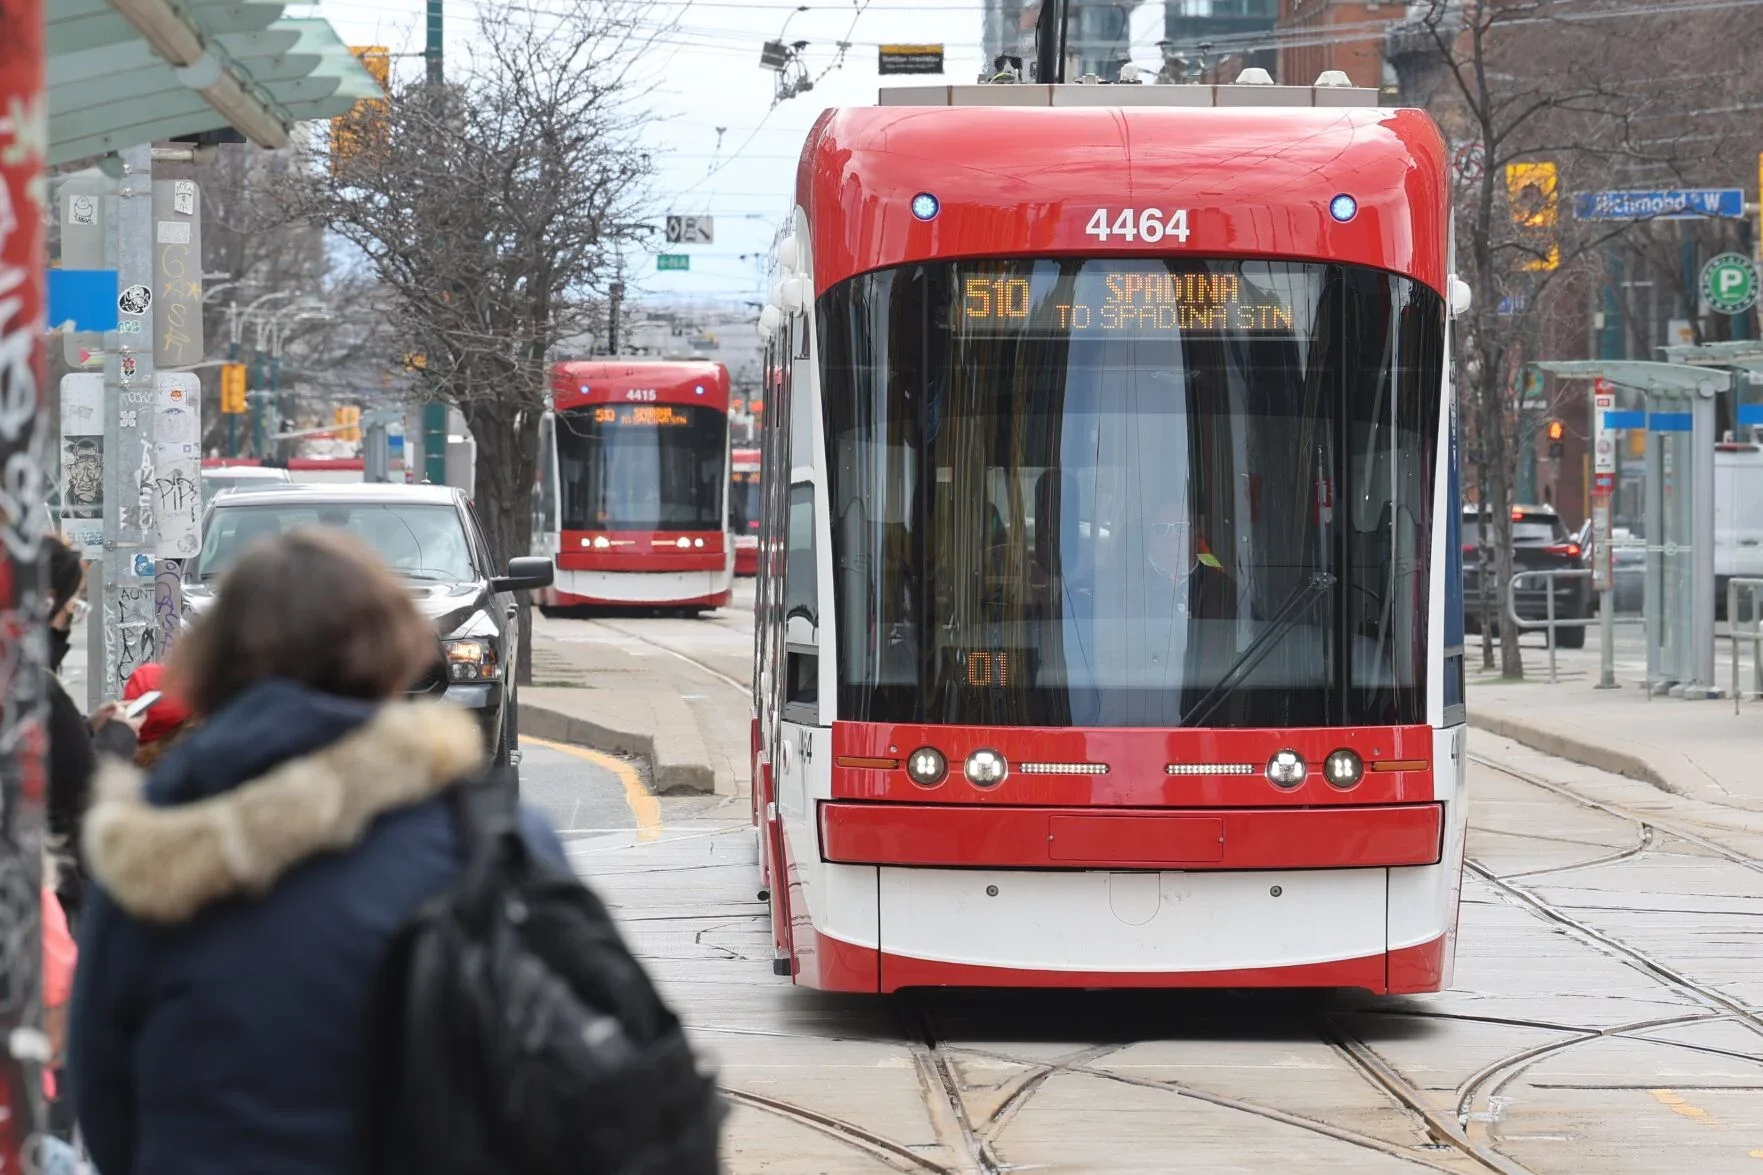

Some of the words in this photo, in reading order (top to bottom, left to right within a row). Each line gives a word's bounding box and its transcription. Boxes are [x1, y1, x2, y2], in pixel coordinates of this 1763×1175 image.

[1703, 192, 1721, 212] W
[1085, 208, 1190, 243] 4464
[1106, 273, 1239, 304] SPADINA
[1719, 268, 1744, 294] P
[966, 279, 1029, 317] 510
[1056, 305, 1091, 329] TO
[1100, 305, 1227, 330] SPADINA
[1237, 305, 1292, 330] STN
[626, 388, 657, 401] 4415
[968, 652, 1007, 687] 01
